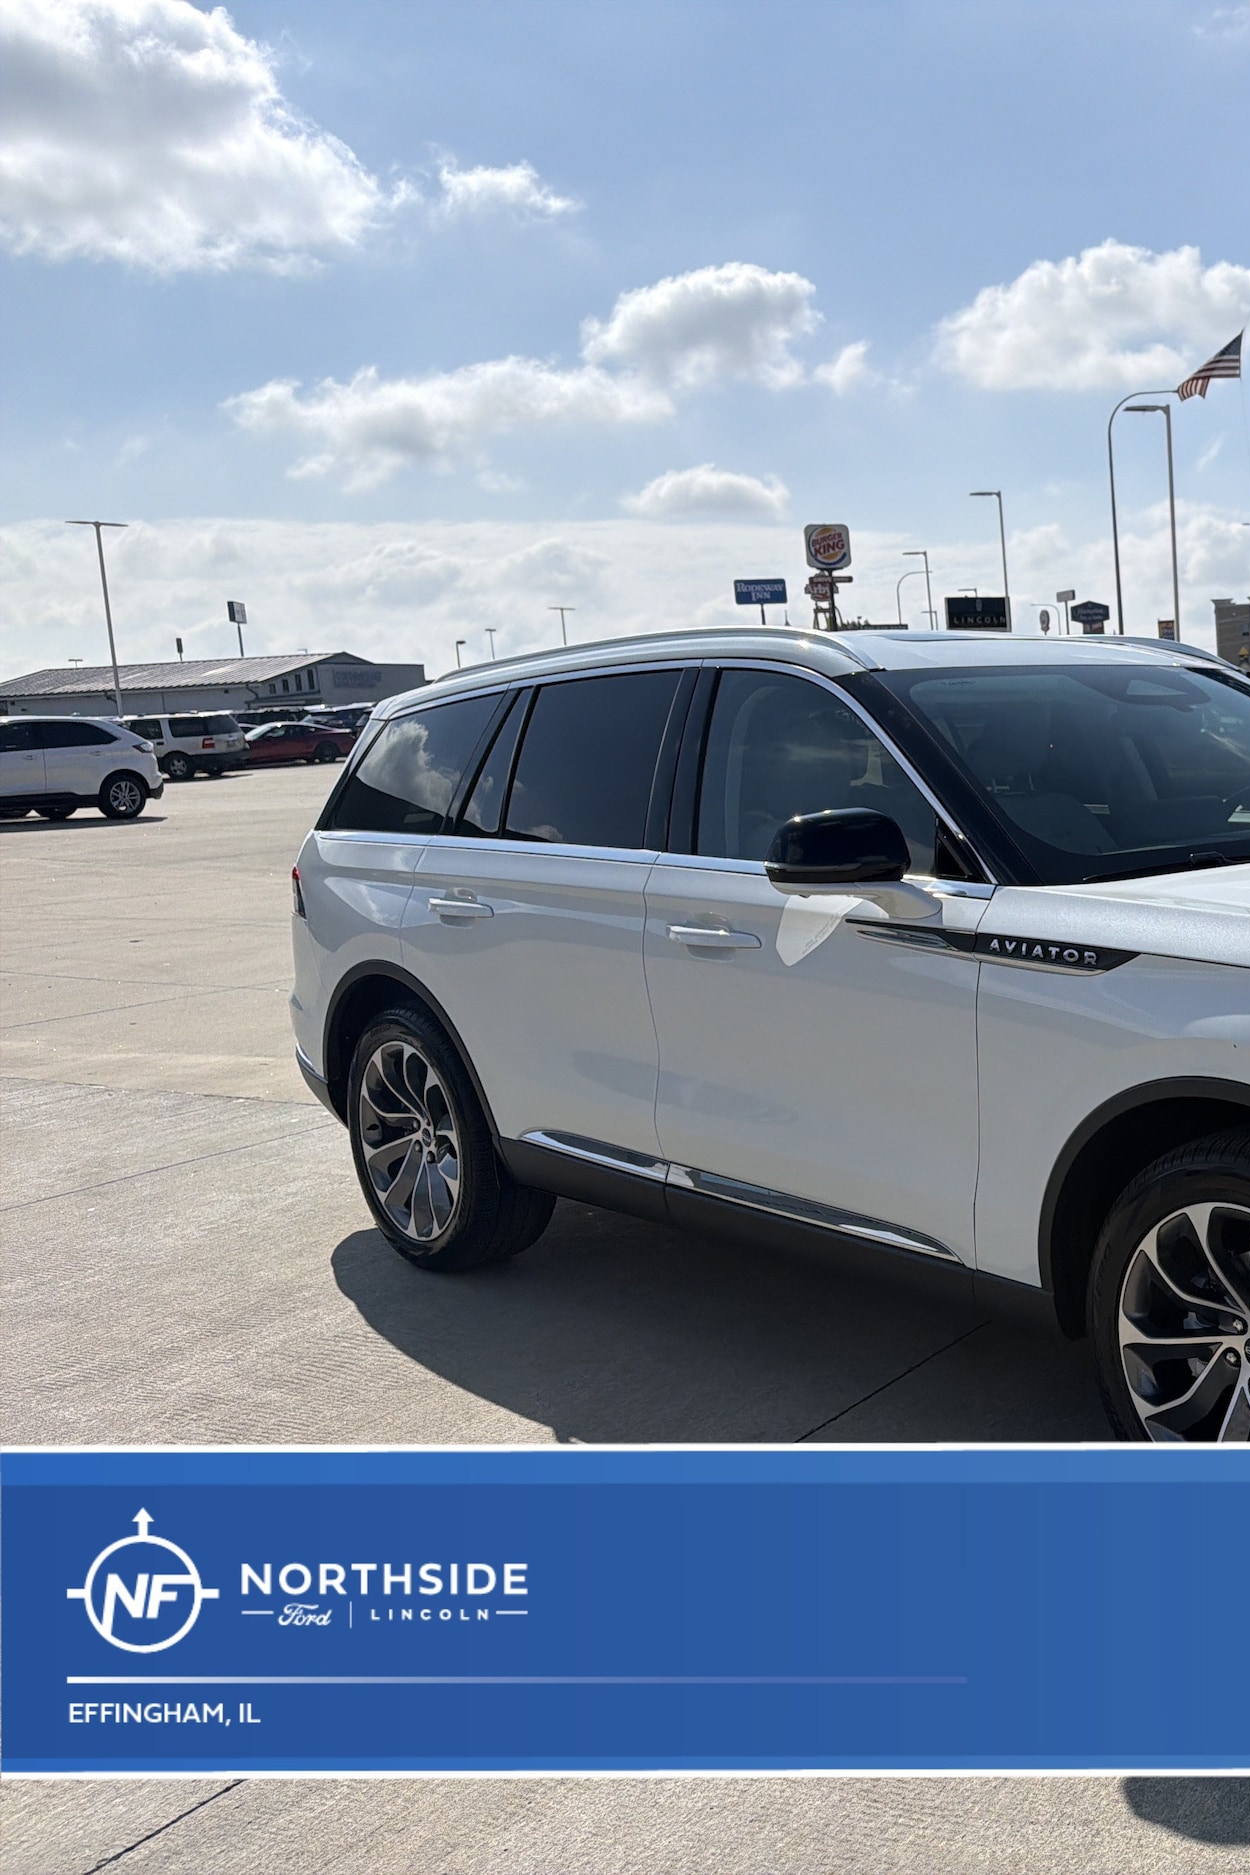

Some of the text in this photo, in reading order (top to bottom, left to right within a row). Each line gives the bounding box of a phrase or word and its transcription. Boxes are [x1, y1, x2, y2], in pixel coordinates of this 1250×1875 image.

[812, 532, 843, 548] BURGER
[814, 540, 845, 557] KING
[736, 582, 784, 593] RODEWAY
[751, 591, 771, 601] INN
[953, 615, 1006, 625] LINCOLN
[989, 938, 1097, 965] AVIATOR
